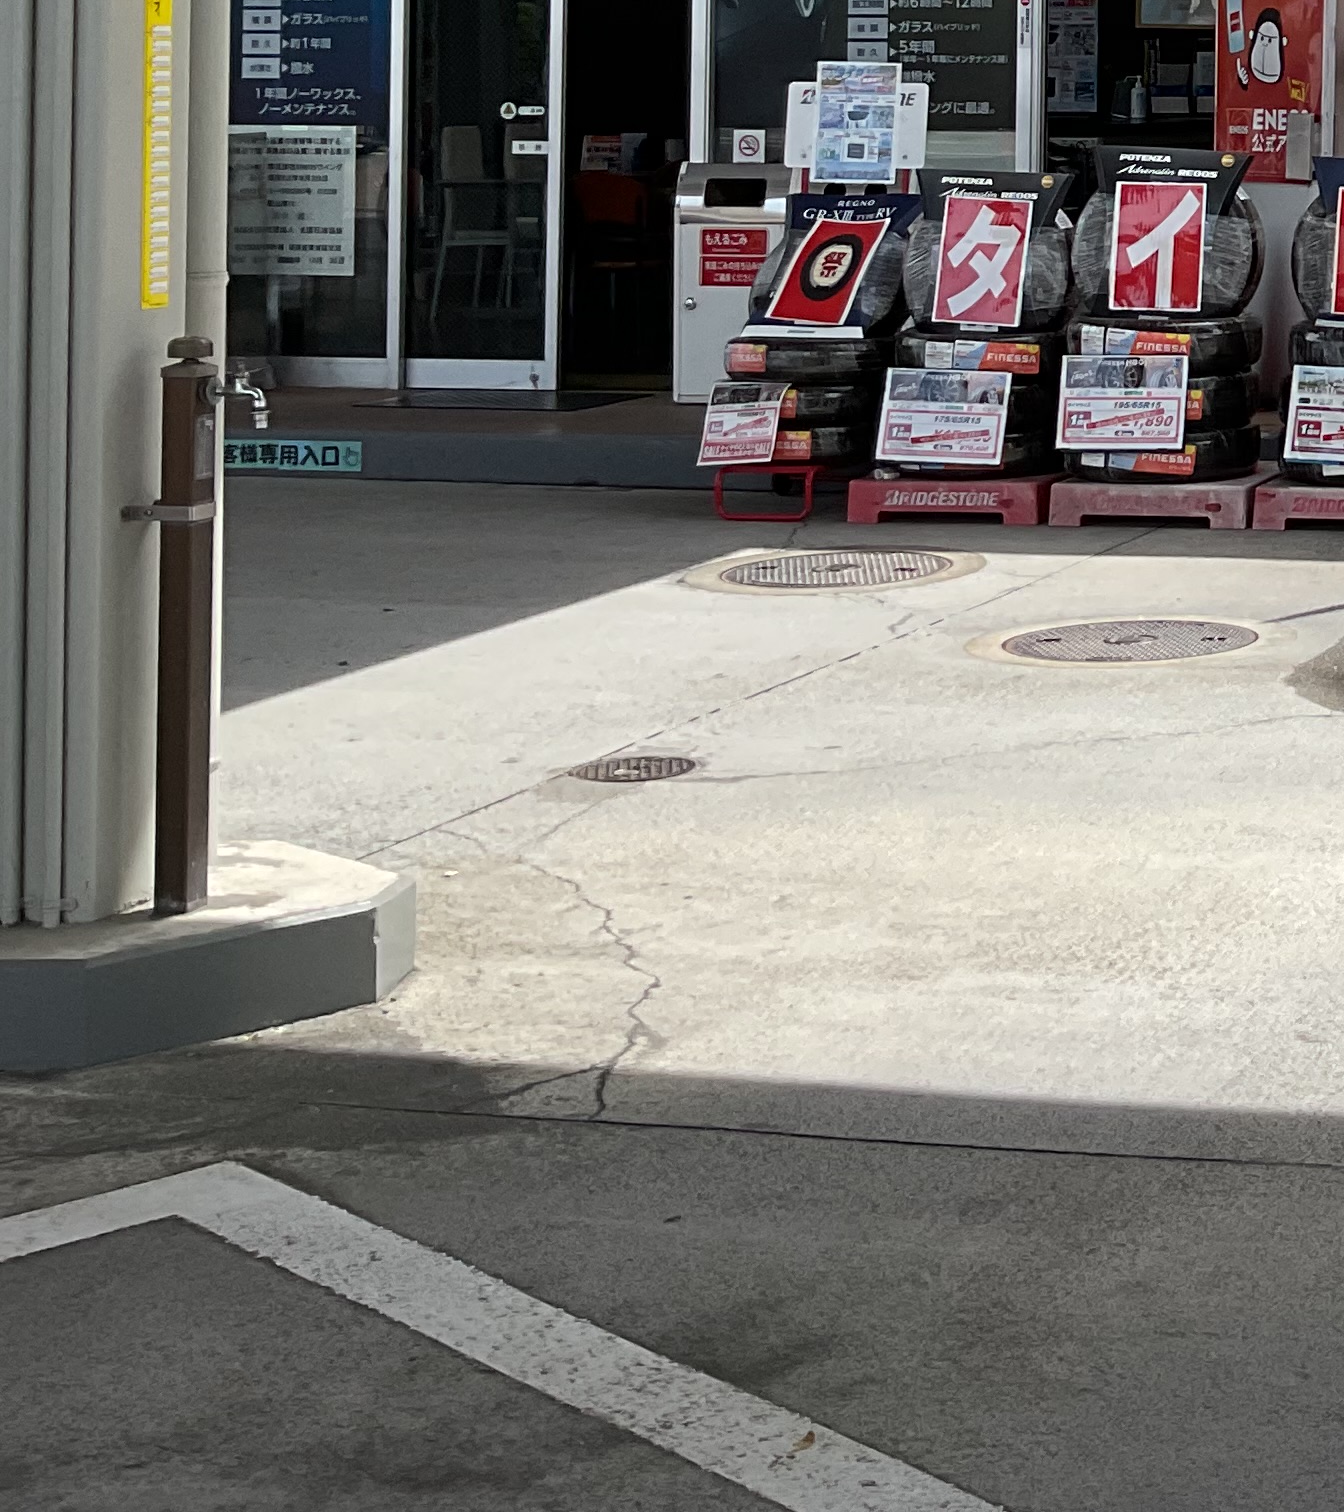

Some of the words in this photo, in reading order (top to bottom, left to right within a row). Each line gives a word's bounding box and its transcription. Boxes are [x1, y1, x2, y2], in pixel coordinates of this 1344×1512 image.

[1252, 108, 1308, 131] ENE
[1119, 154, 1171, 163] POTENZA
[941, 177, 993, 186] POTENZA
[1126, 190, 1200, 310] イ
[946, 204, 1022, 318] タ
[1135, 342, 1188, 353] FINESSA
[986, 353, 1037, 363] FINESSA
[1141, 453, 1192, 463] FINESSA
[884, 490, 999, 506] BRIDGESTONE
